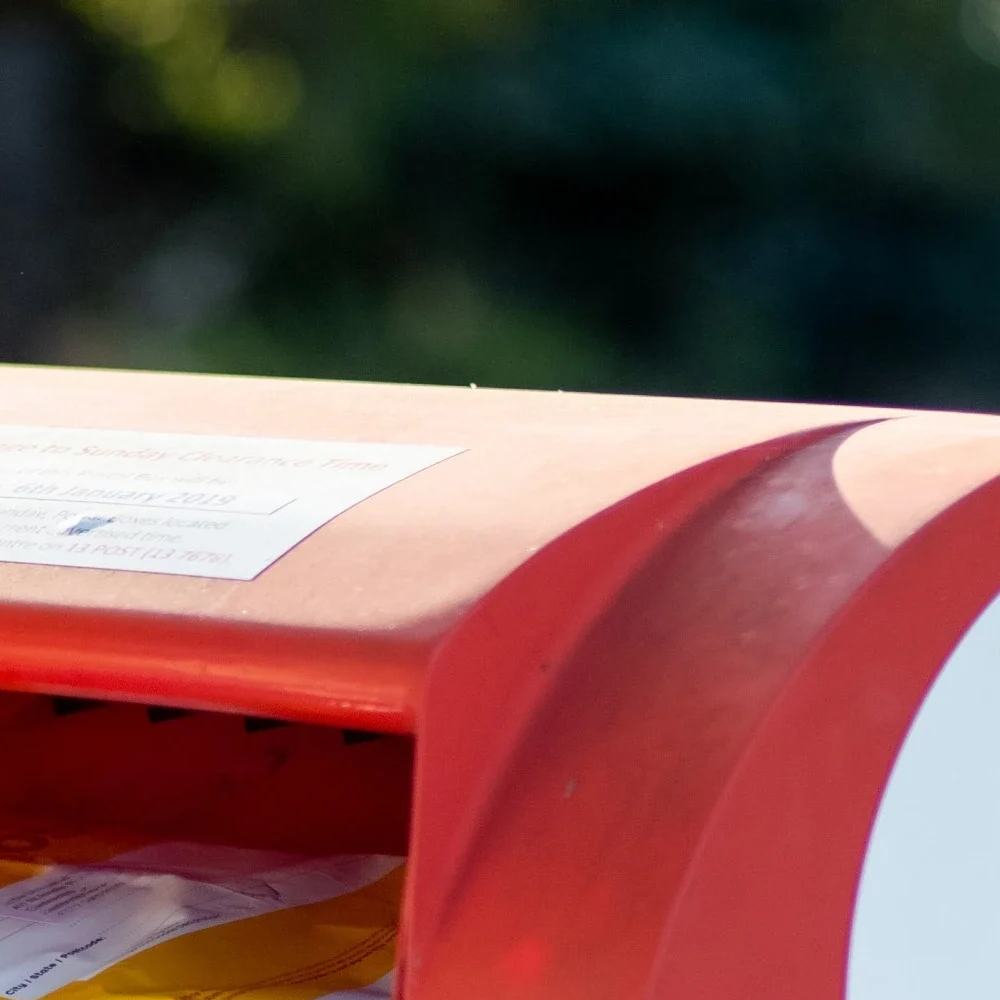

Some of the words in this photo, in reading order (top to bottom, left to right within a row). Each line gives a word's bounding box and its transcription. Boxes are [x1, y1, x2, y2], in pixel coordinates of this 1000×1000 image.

[40, 443, 70, 453] to
[75, 445, 173, 461] Sunday
[178, 450, 312, 466] Clearance
[320, 457, 388, 470] Time
[11, 483, 59, 494] 6th
[58, 486, 161, 503] January
[166, 492, 238, 505] 2019
[162, 518, 231, 529] located
[64, 544, 91, 552] 13
[91, 546, 143, 555] POST
[139, 549, 175, 558] (13
[5, 980, 28, 997] City
[29, 960, 57, 980] State
